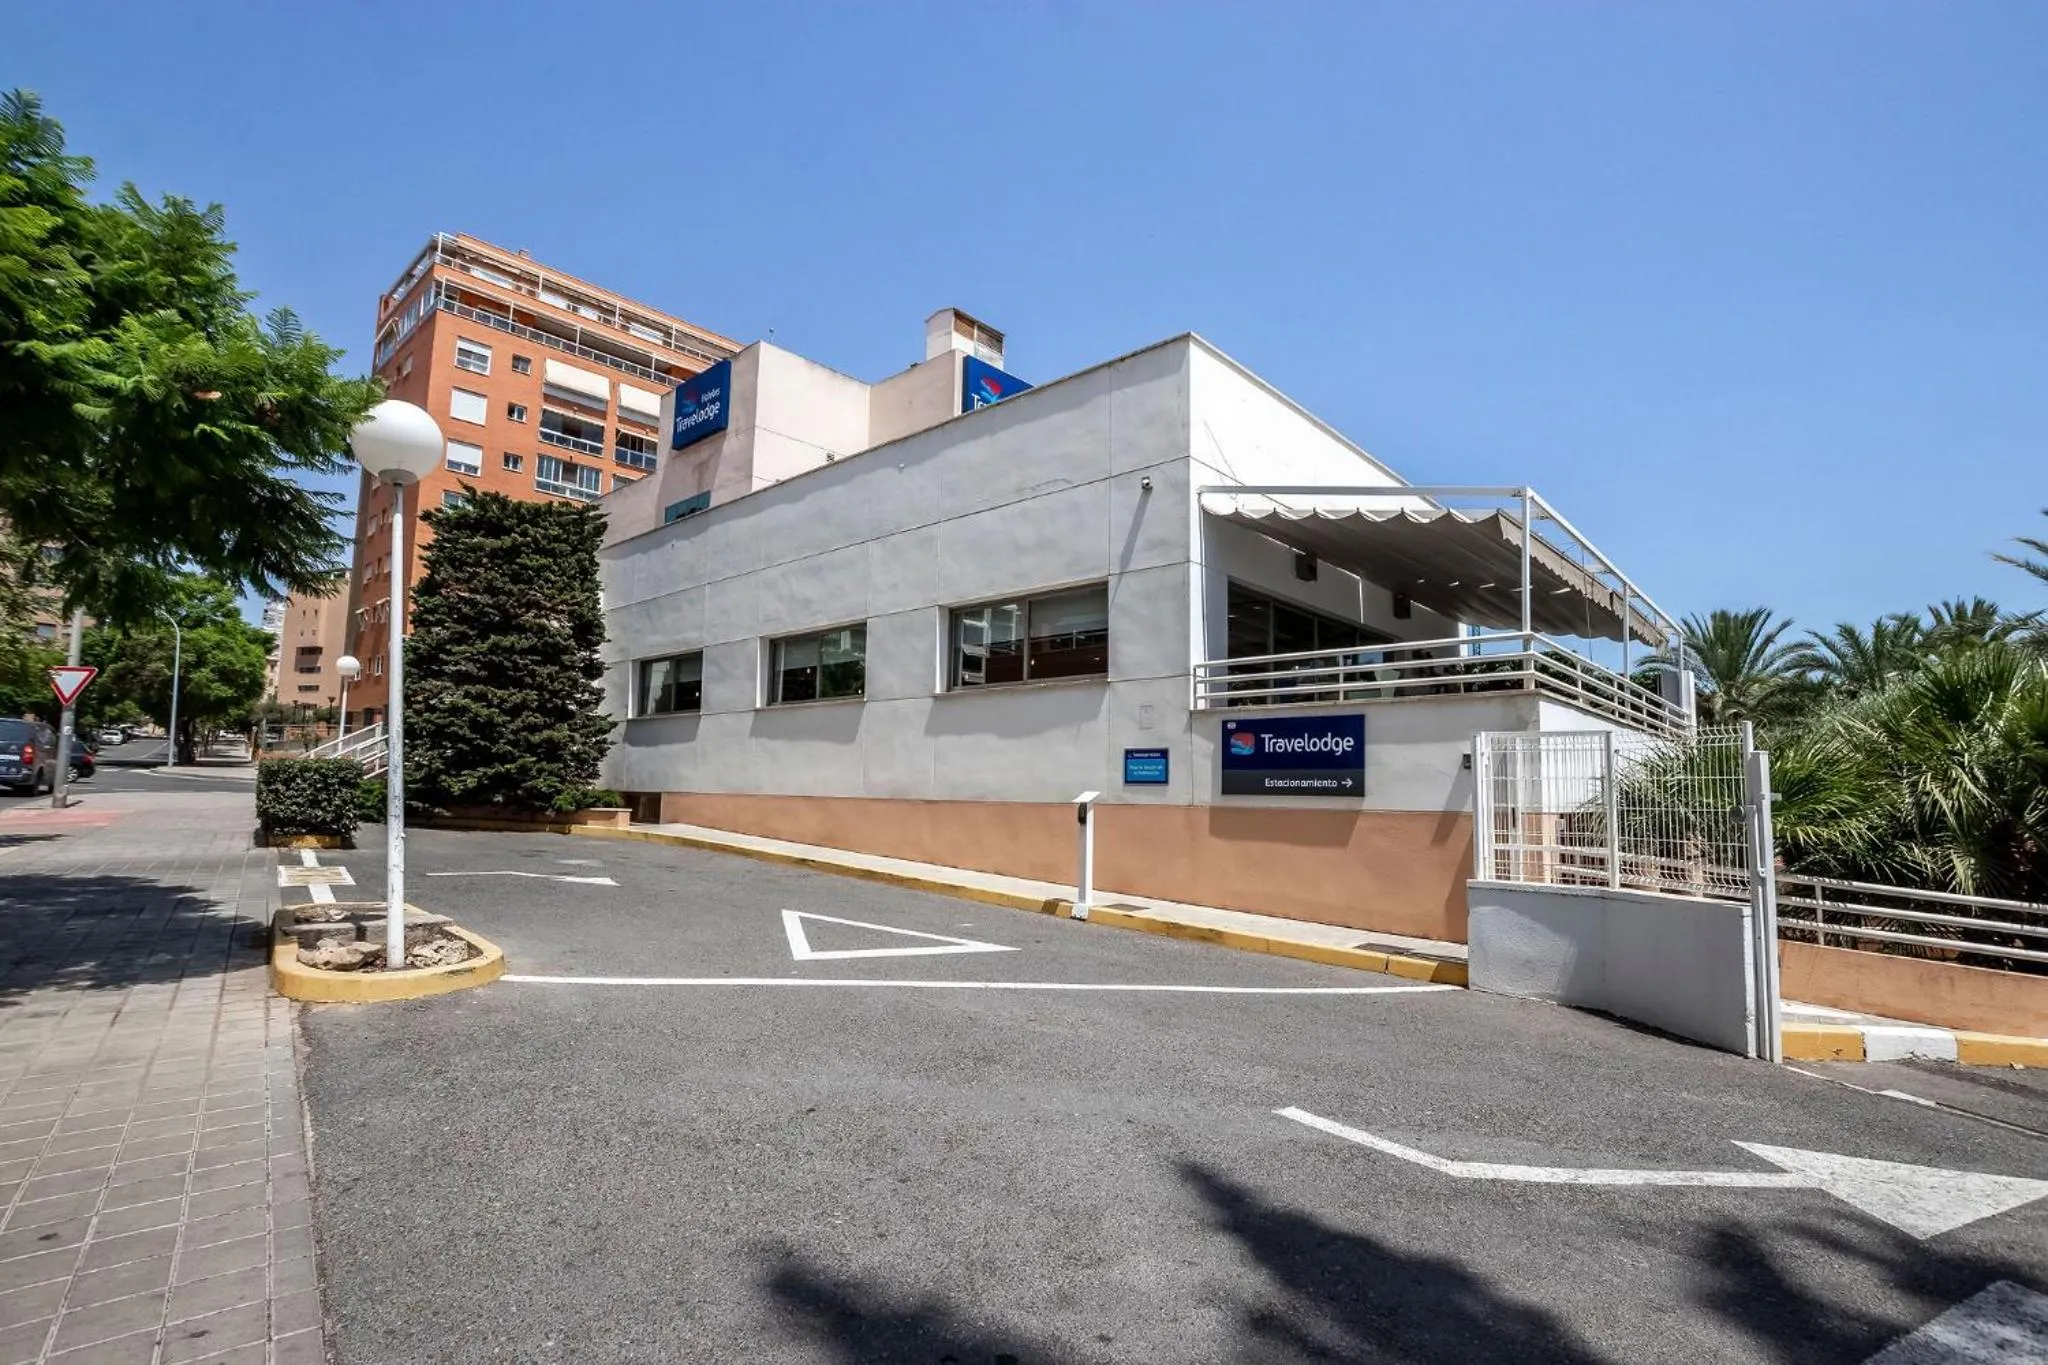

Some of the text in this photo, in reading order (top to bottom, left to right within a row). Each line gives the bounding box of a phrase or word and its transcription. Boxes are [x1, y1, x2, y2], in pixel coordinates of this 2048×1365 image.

[676, 401, 720, 433] Travelodge
[1260, 732, 1355, 756] Travelodge
[1264, 778, 1338, 787] Estacionamiento
